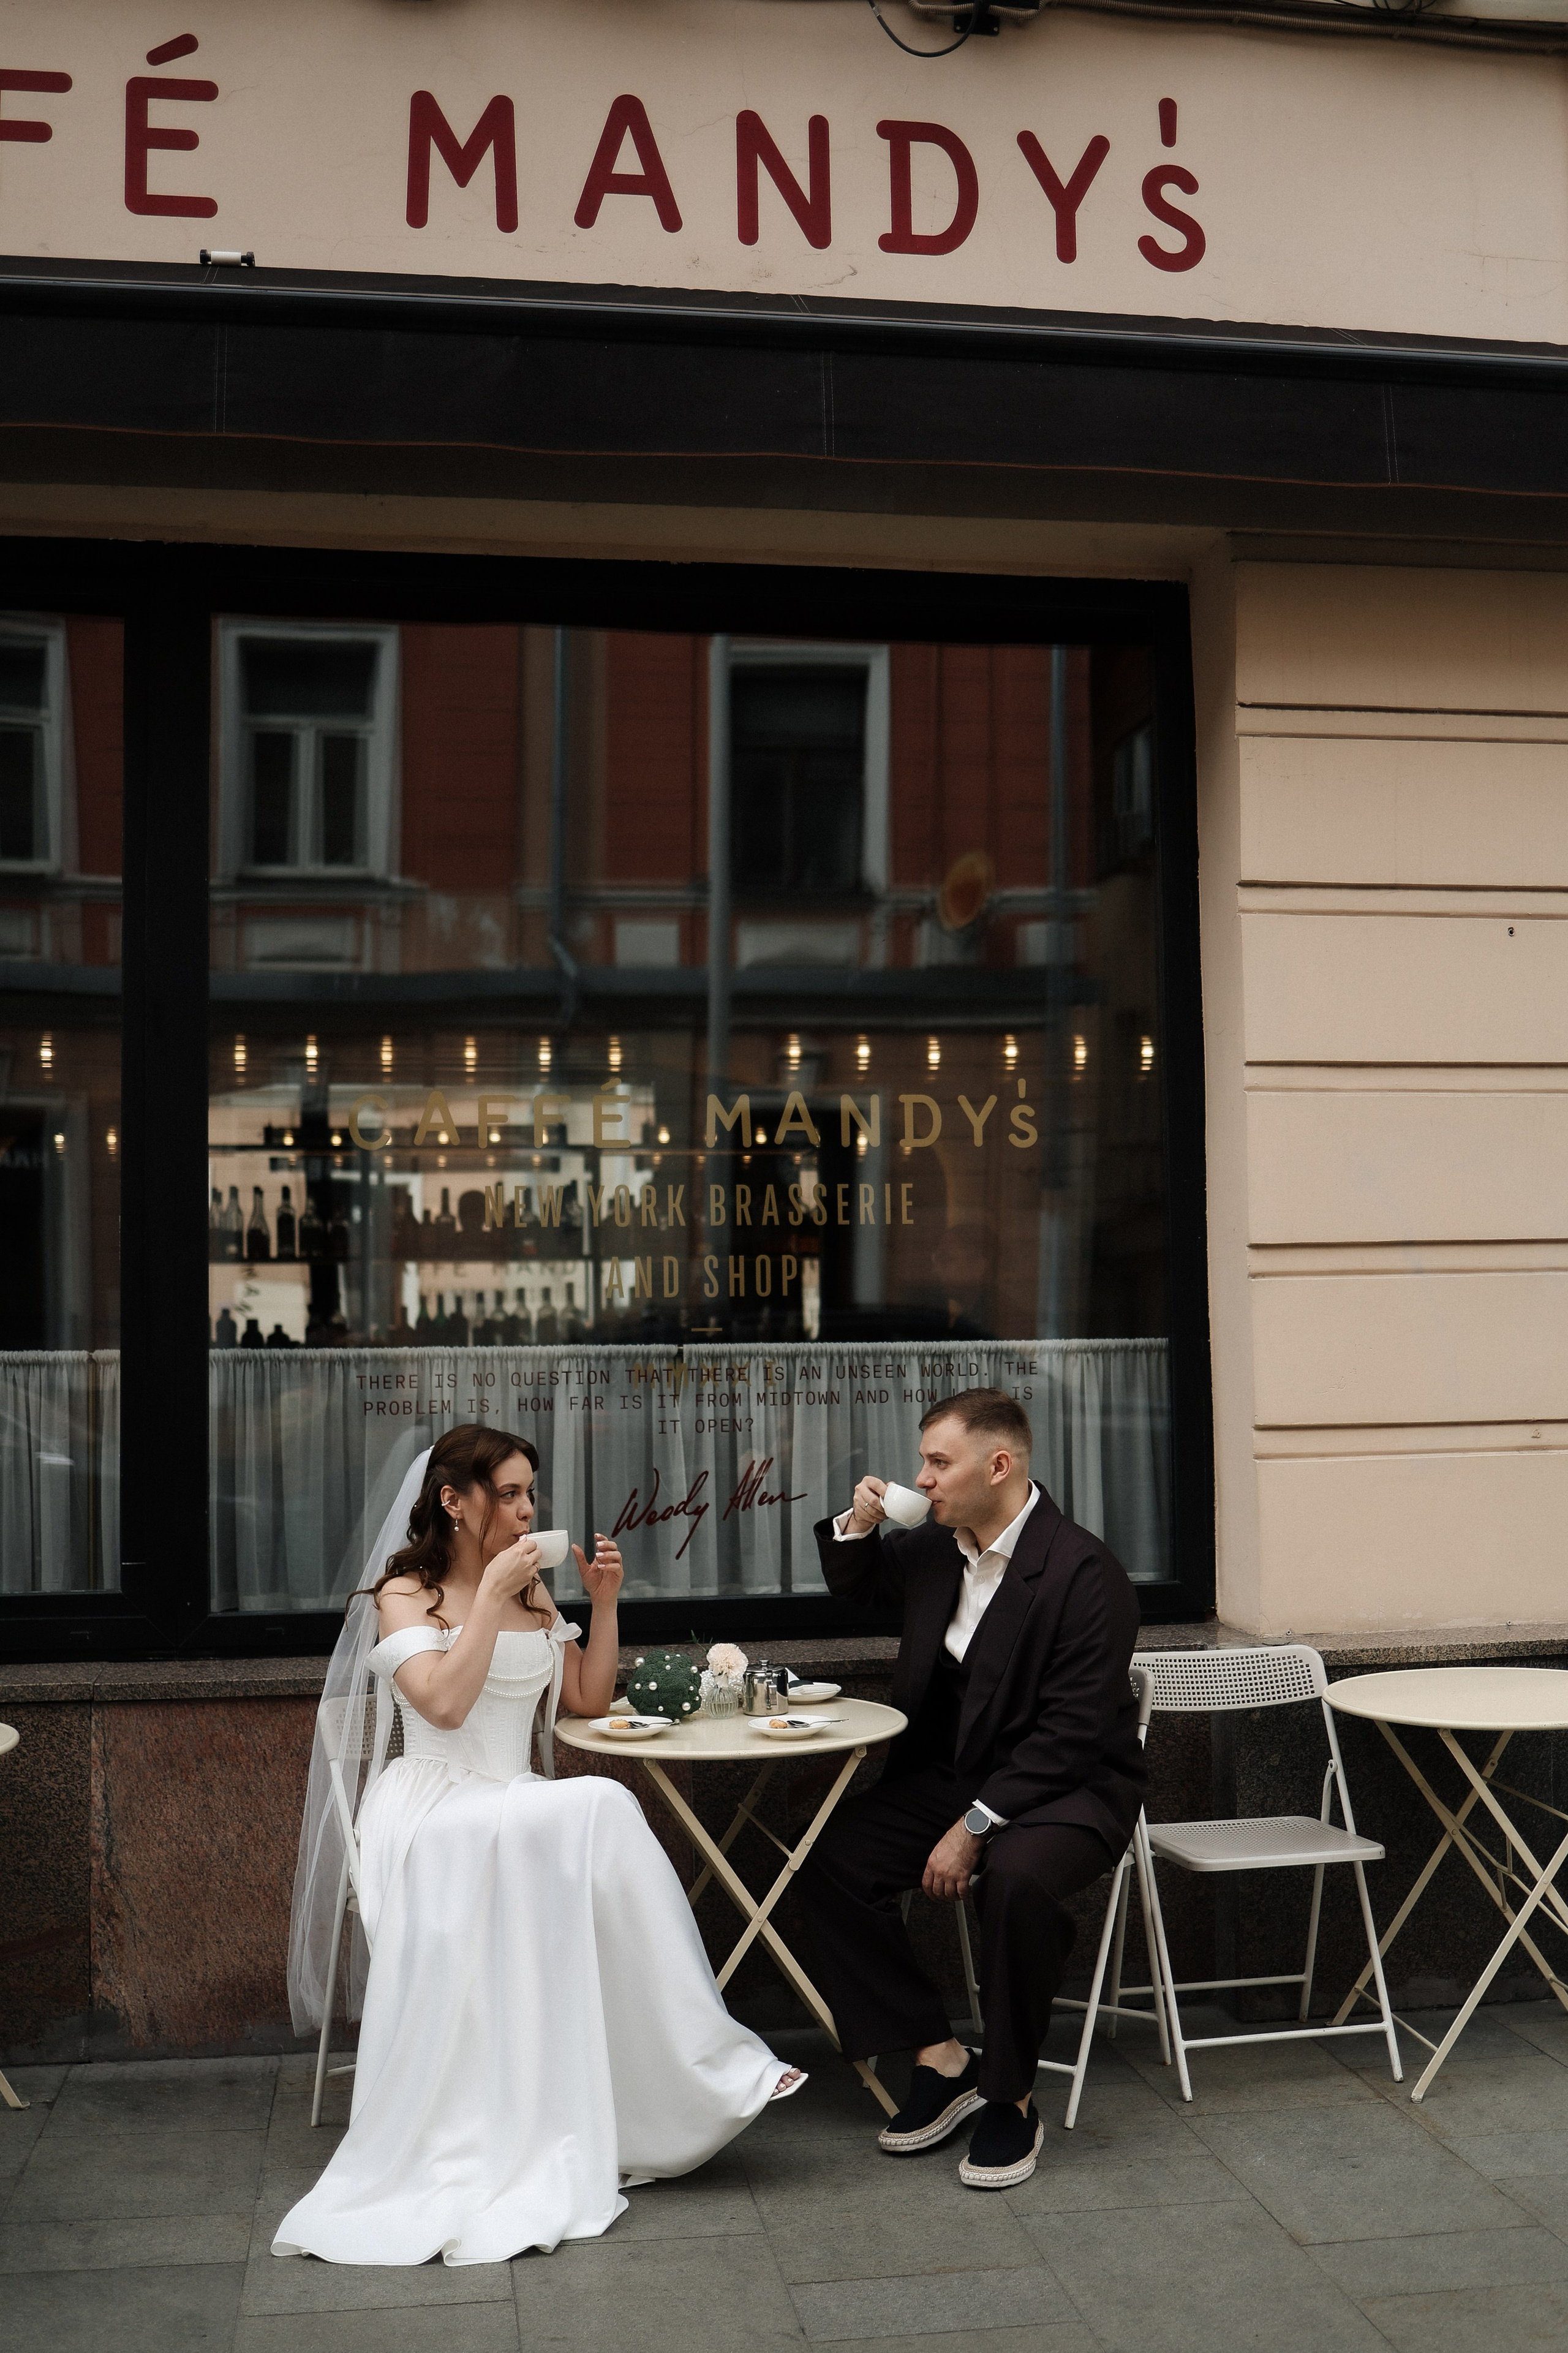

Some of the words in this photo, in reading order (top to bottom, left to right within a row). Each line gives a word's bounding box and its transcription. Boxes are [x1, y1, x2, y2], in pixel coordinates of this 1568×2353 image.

[405, 90, 1207, 273] MANDY's
[348, 1078, 631, 1151] CAFFÉ
[705, 1078, 1038, 1149] MANDY's
[484, 1185, 564, 1228] NEW
[587, 1184, 687, 1227] YORK
[710, 1182, 914, 1227] BRASSERIE
[606, 1255, 680, 1299] AND
[703, 1255, 797, 1298] SHOP
[356, 1375, 418, 1390] THERE
[435, 1373, 458, 1388] IS
[473, 1372, 496, 1388] NO
[511, 1370, 610, 1388] QUESTION
[625, 1369, 673, 1384] THAT
[688, 1366, 748, 1383] THERE
[763, 1366, 785, 1381] IS
[799, 1365, 821, 1380] AN
[836, 1364, 907, 1380] UNSEEN
[921, 1363, 989, 1378] WORLD.
[1005, 1361, 1038, 1375] THE
[364, 1400, 451, 1416] PROBLEM
[467, 1399, 500, 1415] IS,
[518, 1397, 553, 1412] HOW
[570, 1396, 605, 1411] FAR
[620, 1396, 642, 1410] IS
[658, 1395, 679, 1408] IT
[695, 1392, 742, 1408] FROM
[756, 1391, 840, 1407] MIDTOWN
[855, 1389, 889, 1405] AND
[903, 1389, 938, 1403] HOW
[1012, 1386, 1033, 1401] IS
[658, 1420, 680, 1434] IT
[695, 1418, 754, 1433] OPEN?
[611, 1468, 710, 1560] Woody
[723, 1457, 807, 1520] Allen
